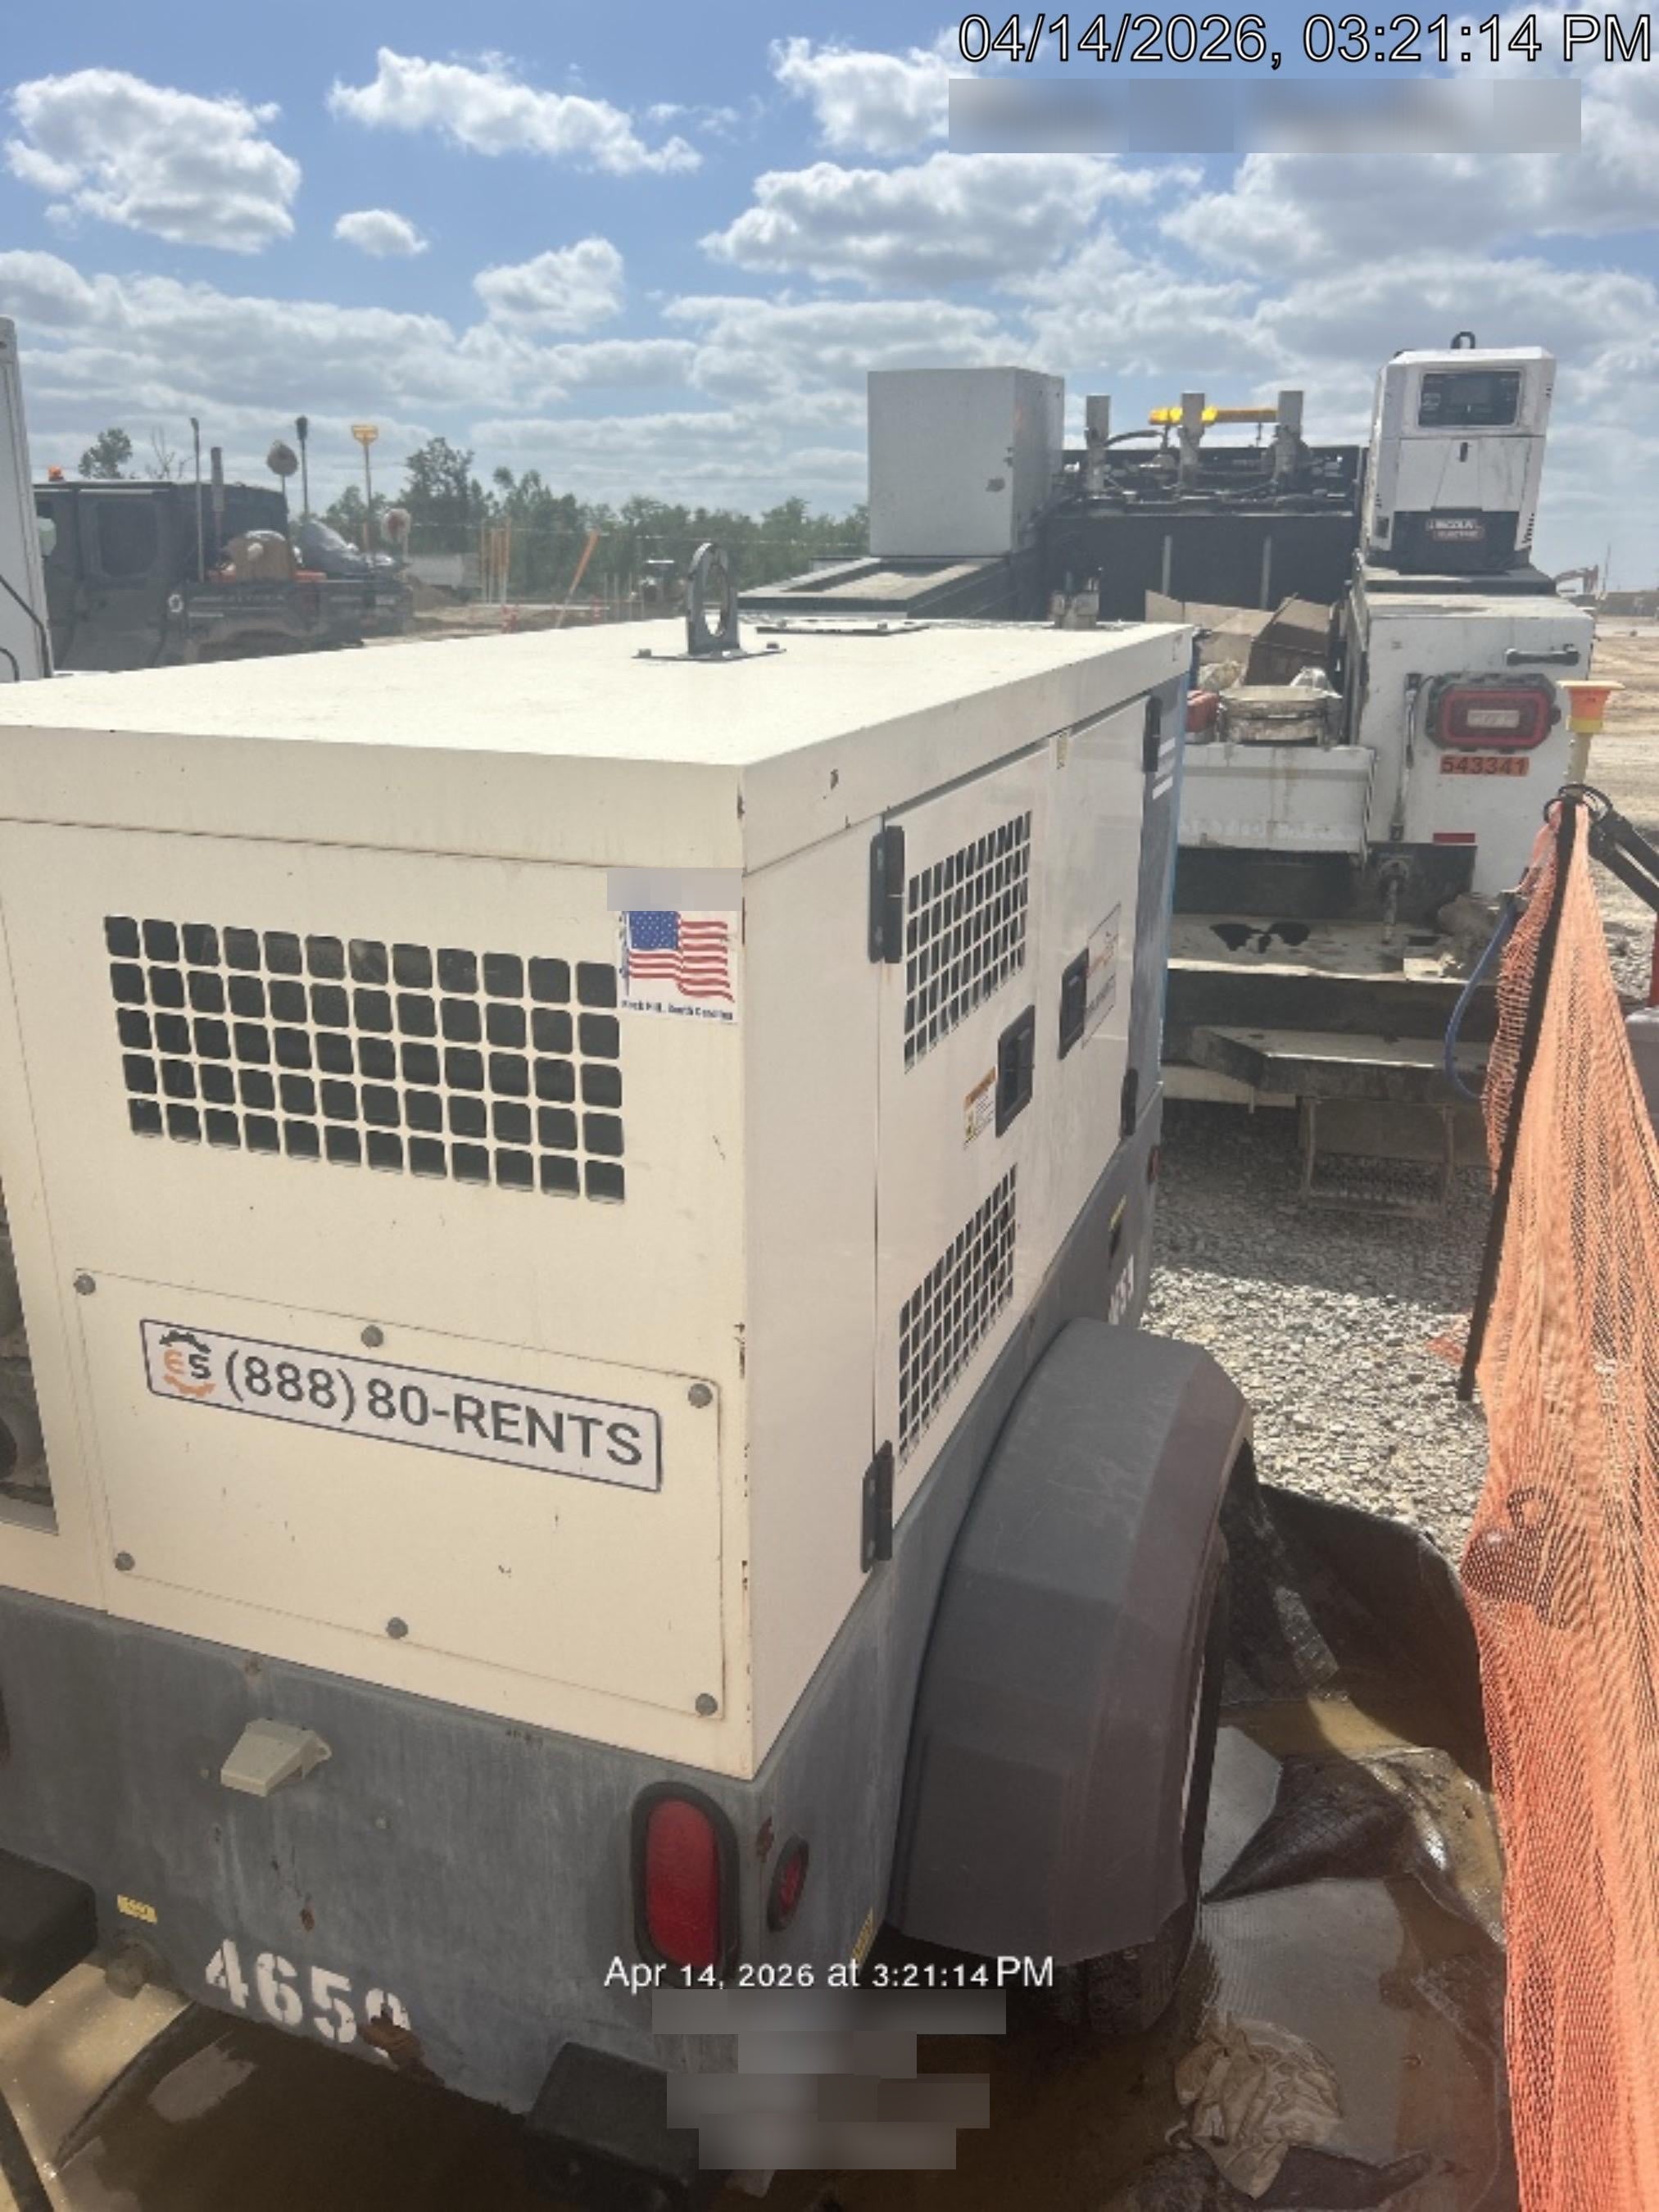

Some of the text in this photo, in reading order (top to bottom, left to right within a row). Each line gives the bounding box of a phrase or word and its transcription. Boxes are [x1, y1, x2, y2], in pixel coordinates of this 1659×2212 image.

[1441, 756, 1525, 775] 543341
[225, 1349, 642, 1466] (888) 80-RENTS
